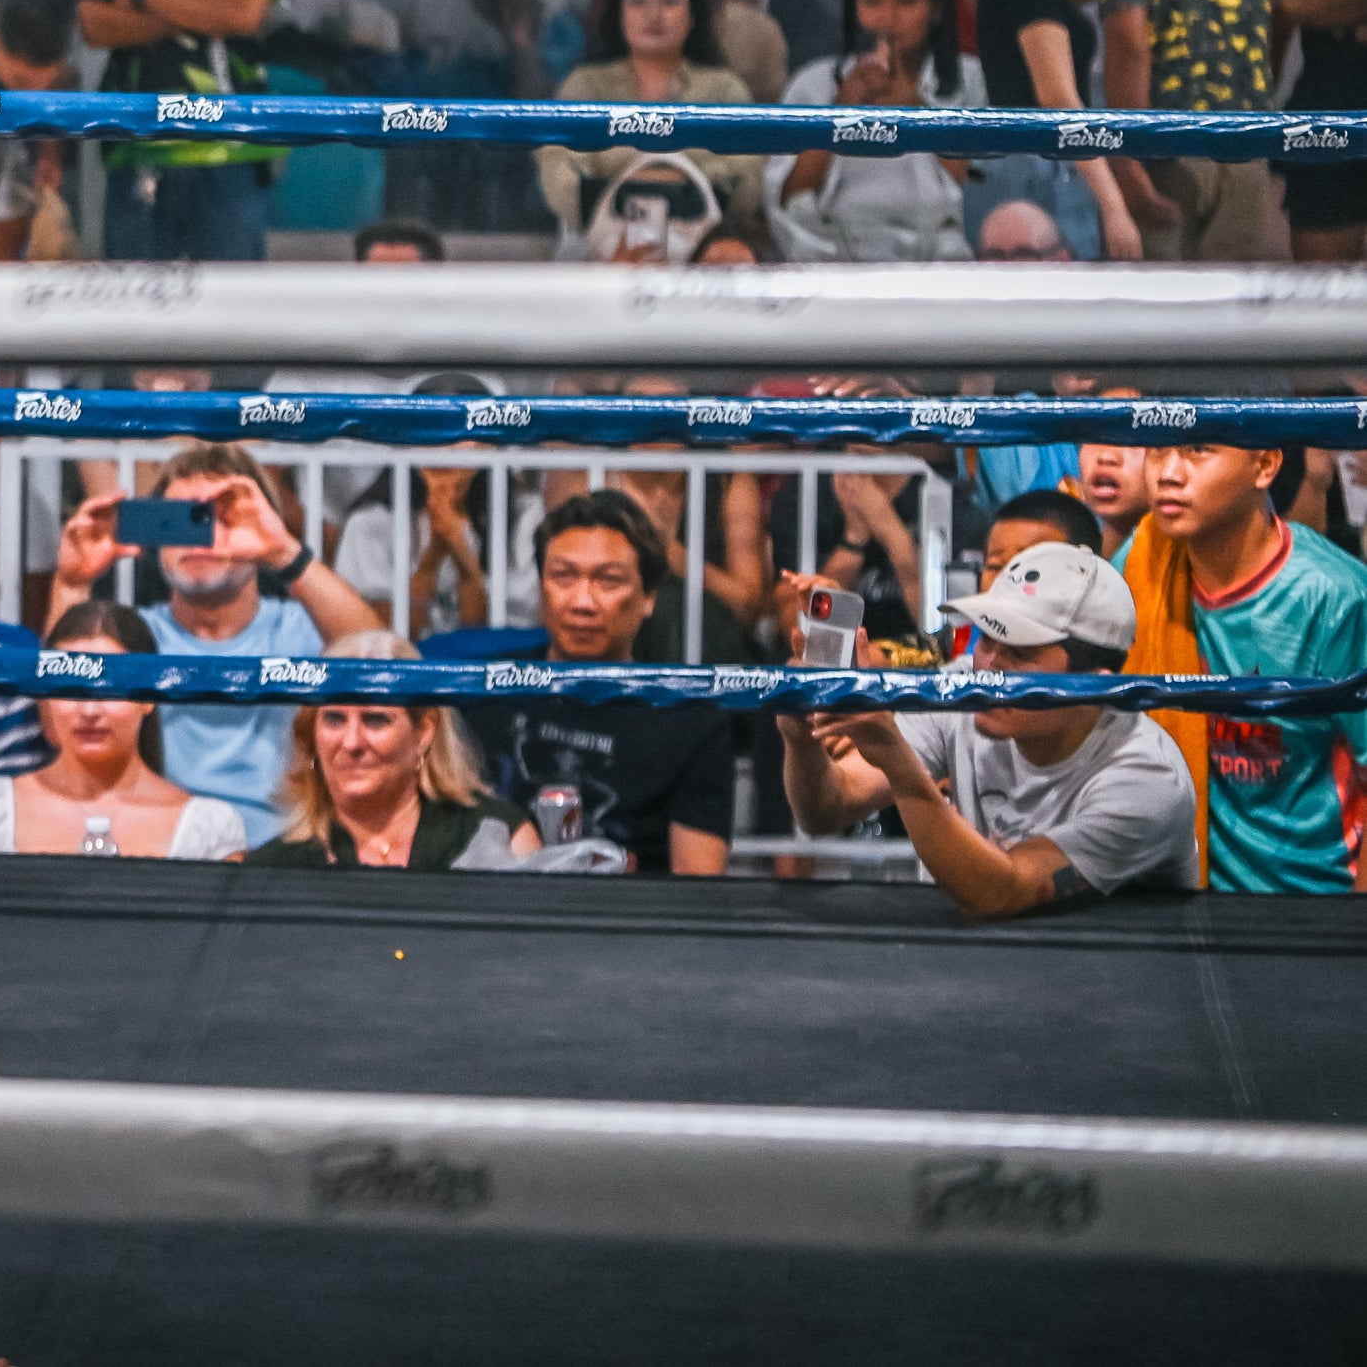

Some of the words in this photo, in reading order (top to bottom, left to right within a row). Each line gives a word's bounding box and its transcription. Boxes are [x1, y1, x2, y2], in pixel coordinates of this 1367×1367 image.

[158, 94, 224, 122] Fairtex
[383, 103, 448, 132] Fairtex
[609, 108, 674, 137] Fairtex
[833, 117, 898, 144] Fairtex
[1058, 122, 1124, 150] Fairtex
[1284, 125, 1349, 152] Fairtex
[14, 392, 81, 421] Fairtex
[239, 395, 306, 426] Fairtex
[466, 398, 532, 429] Fairtex
[688, 397, 753, 426] Fairtex
[1132, 403, 1197, 430] Fairtex
[37, 651, 104, 679] Fairtex
[260, 658, 327, 685] Fairtex
[485, 663, 553, 690] Fairtex
